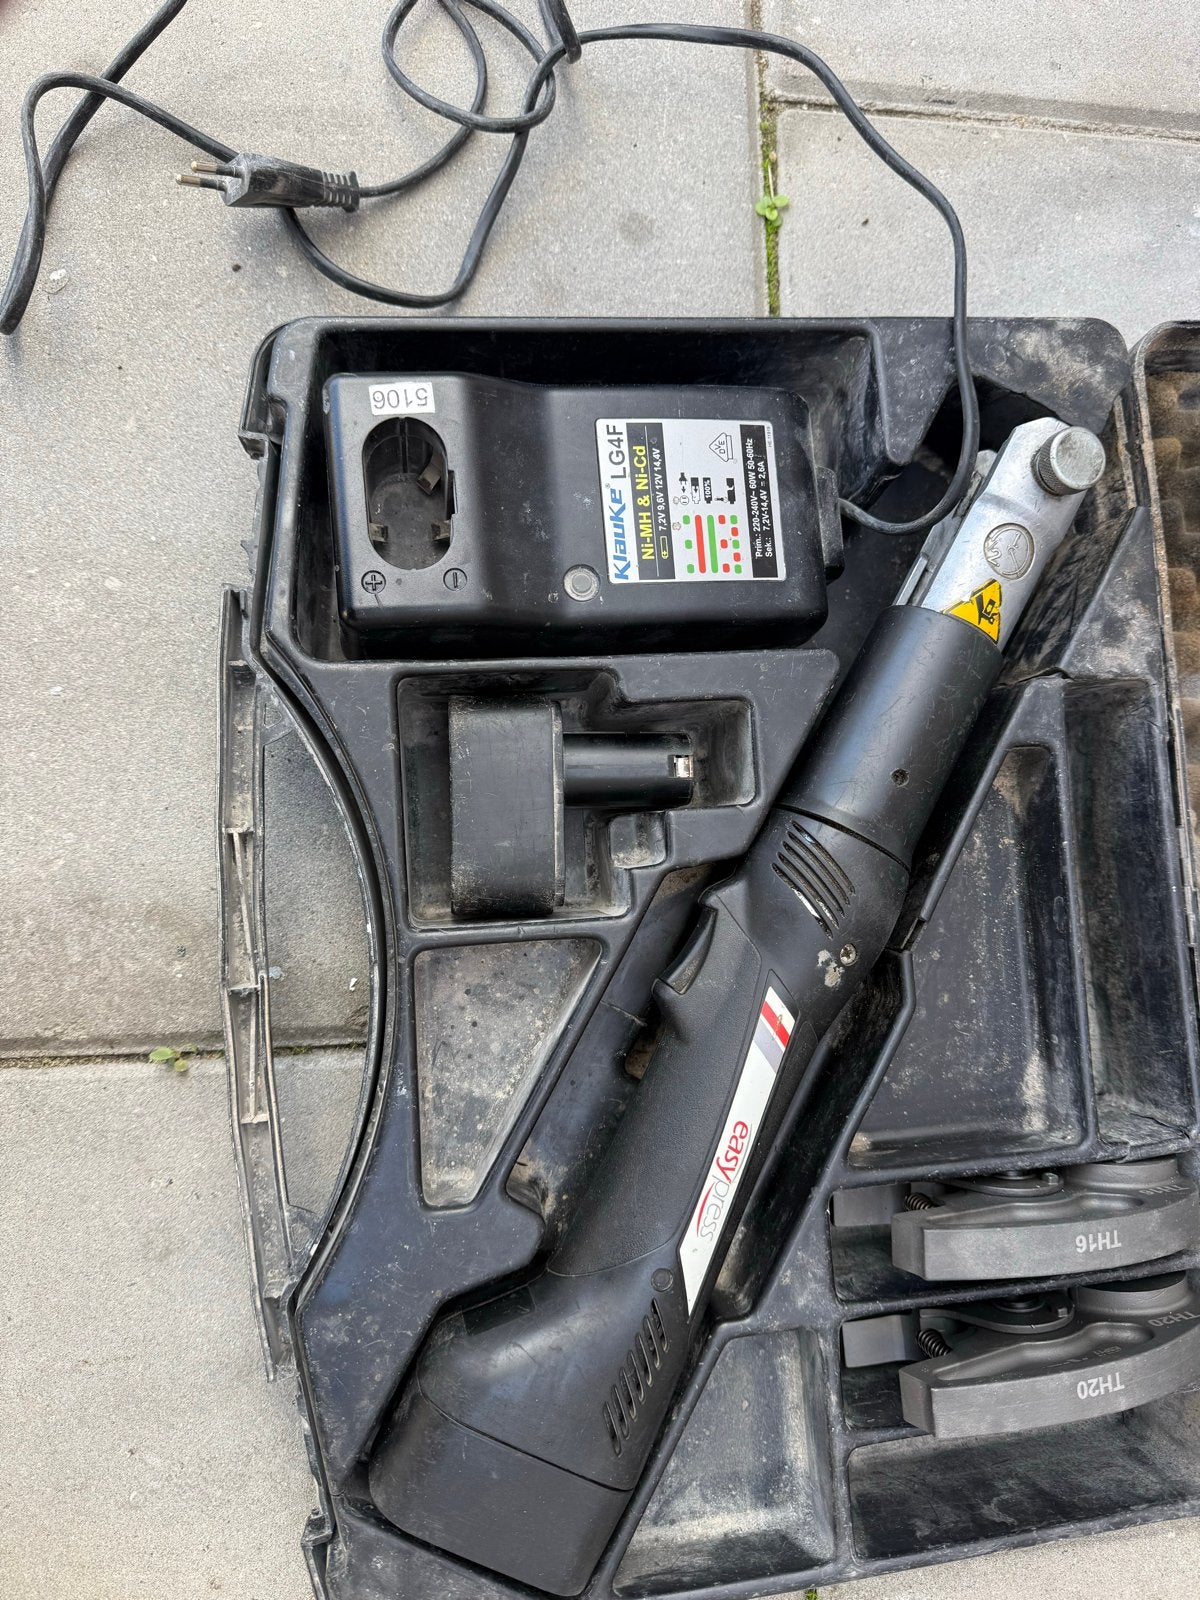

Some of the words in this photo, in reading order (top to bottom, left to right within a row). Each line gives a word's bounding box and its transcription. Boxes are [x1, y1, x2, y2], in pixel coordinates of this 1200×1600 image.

[372, 387, 429, 409] 5106
[606, 424, 627, 479] LG4F
[652, 447, 662, 472] 14,4V
[745, 438, 756, 470] 50-60Hz
[633, 445, 650, 490] Ni-Cd
[654, 473, 664, 490] 12V
[703, 479, 712, 499] 100%
[748, 471, 758, 489] 60W
[637, 495, 650, 507] &
[656, 491, 666, 511] 9,6V
[658, 512, 668, 531] 7,2V
[637, 511, 655, 560] Ni-MH
[754, 533, 764, 558] Prim.:
[763, 537, 773, 557] Sek.:
[1075, 1229, 1122, 1254] TH16
[1076, 1371, 1125, 1400] TH20
